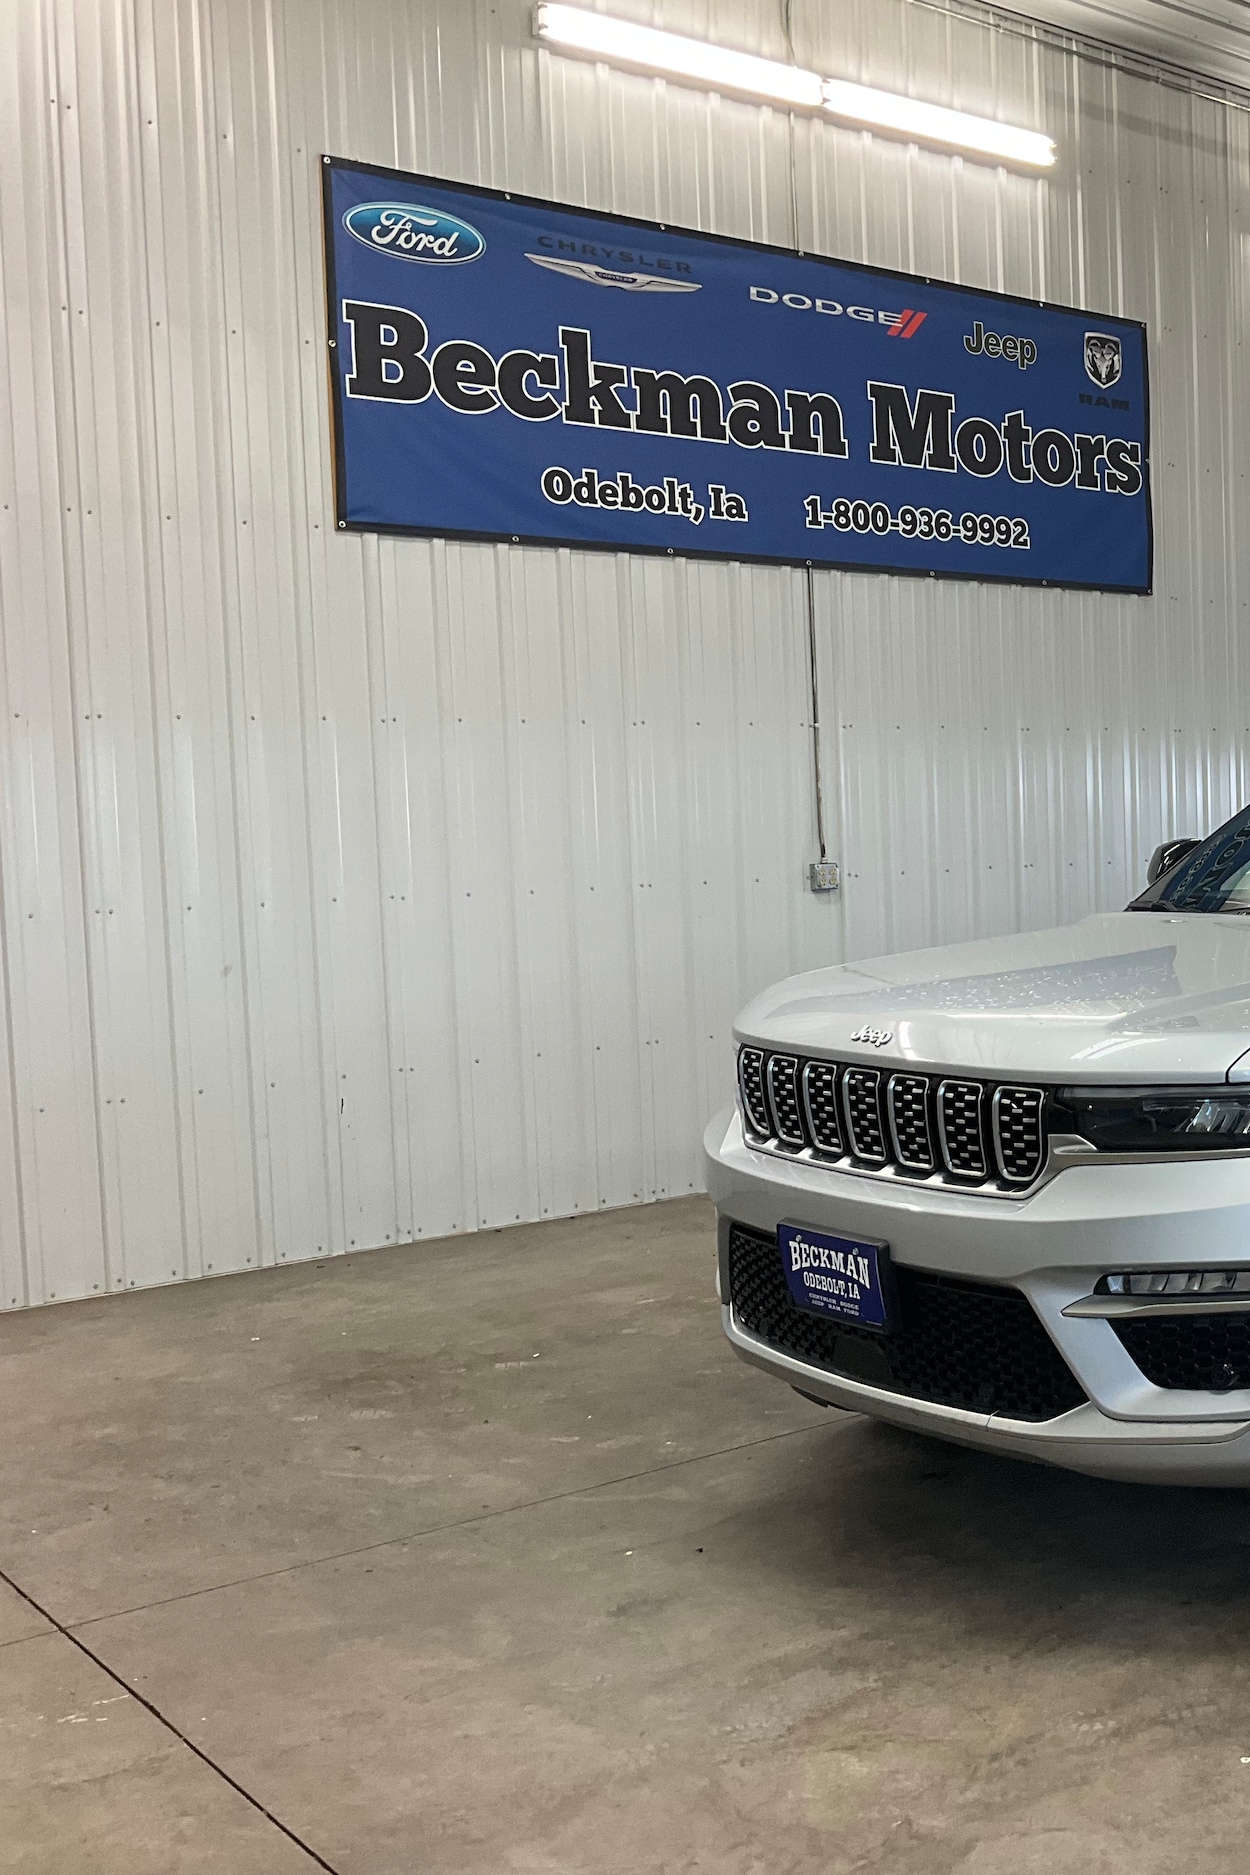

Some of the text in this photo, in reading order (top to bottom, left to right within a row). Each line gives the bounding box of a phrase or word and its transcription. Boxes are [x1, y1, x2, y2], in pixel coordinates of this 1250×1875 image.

[370, 208, 461, 259] Ford
[537, 235, 693, 274] CHRYSLER
[749, 285, 905, 327] DODGE
[963, 321, 1038, 370] Jeep
[341, 298, 1143, 496] Beckman Motors
[1078, 393, 1131, 412] RAM
[541, 466, 749, 526] Odebolt, Ia
[803, 495, 1031, 550] 1-800-936-9992
[850, 1024, 893, 1048] Jeep
[788, 1240, 871, 1290] BECKMAN
[803, 1271, 861, 1300] ODEBOLT, IA
